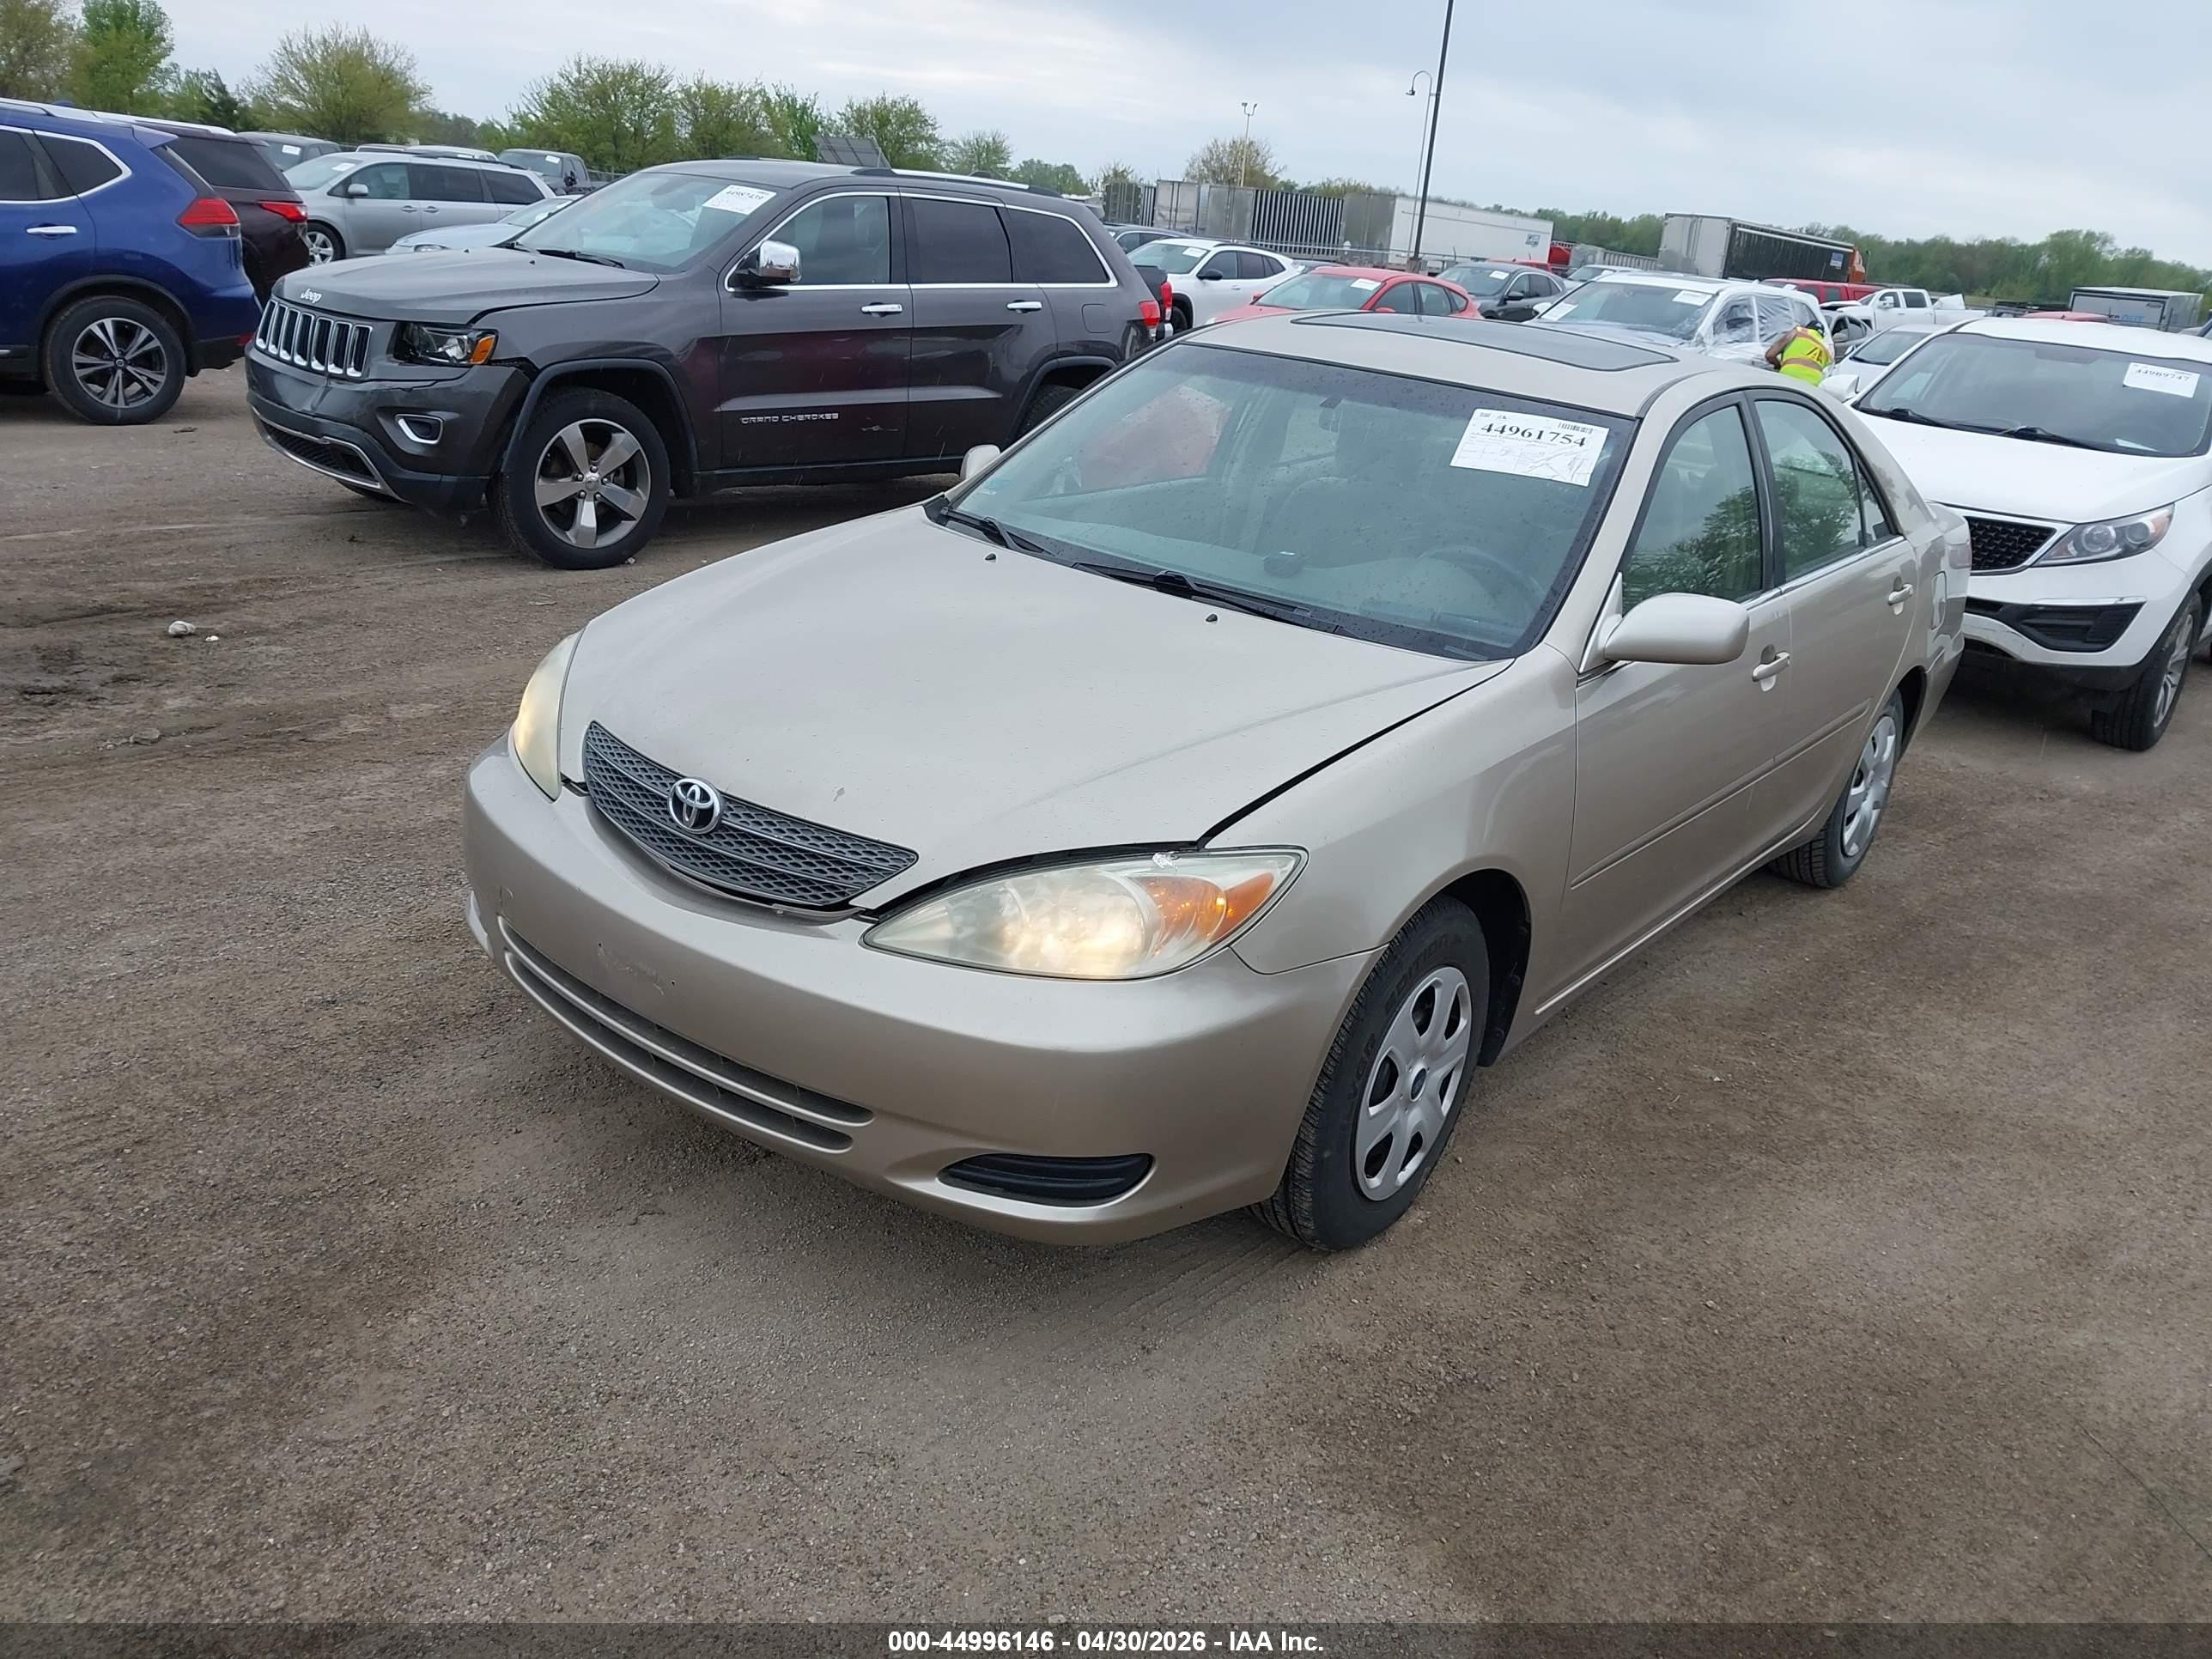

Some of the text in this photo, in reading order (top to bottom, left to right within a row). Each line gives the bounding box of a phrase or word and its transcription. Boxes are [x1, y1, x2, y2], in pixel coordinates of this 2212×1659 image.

[301, 289, 322, 303] Jeep
[741, 413, 839, 424] GRAND CHEROKEE
[1480, 422, 1588, 447] 44961754
